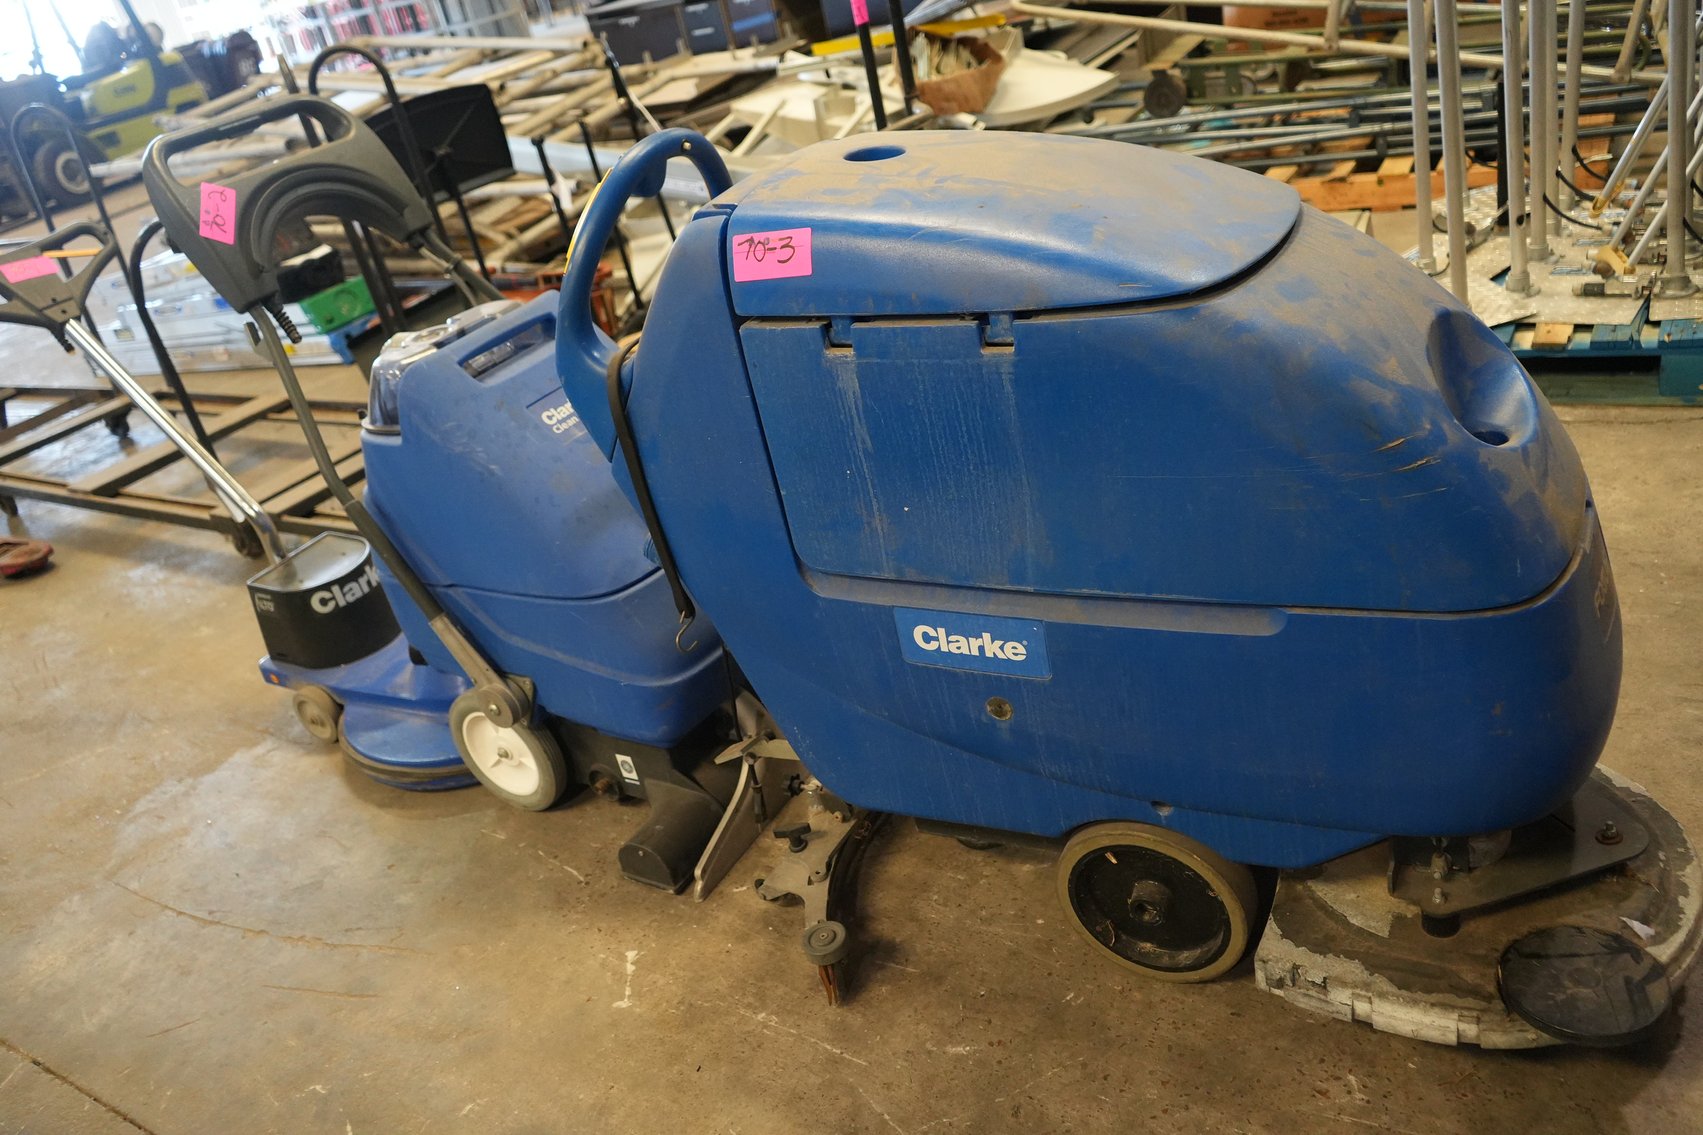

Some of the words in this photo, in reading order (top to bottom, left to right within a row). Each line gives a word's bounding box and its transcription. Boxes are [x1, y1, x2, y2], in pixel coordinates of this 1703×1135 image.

[737, 235, 796, 264] 70-3
[541, 399, 575, 425] Clar
[310, 565, 379, 614] Clark
[913, 624, 1028, 661] Clarke
